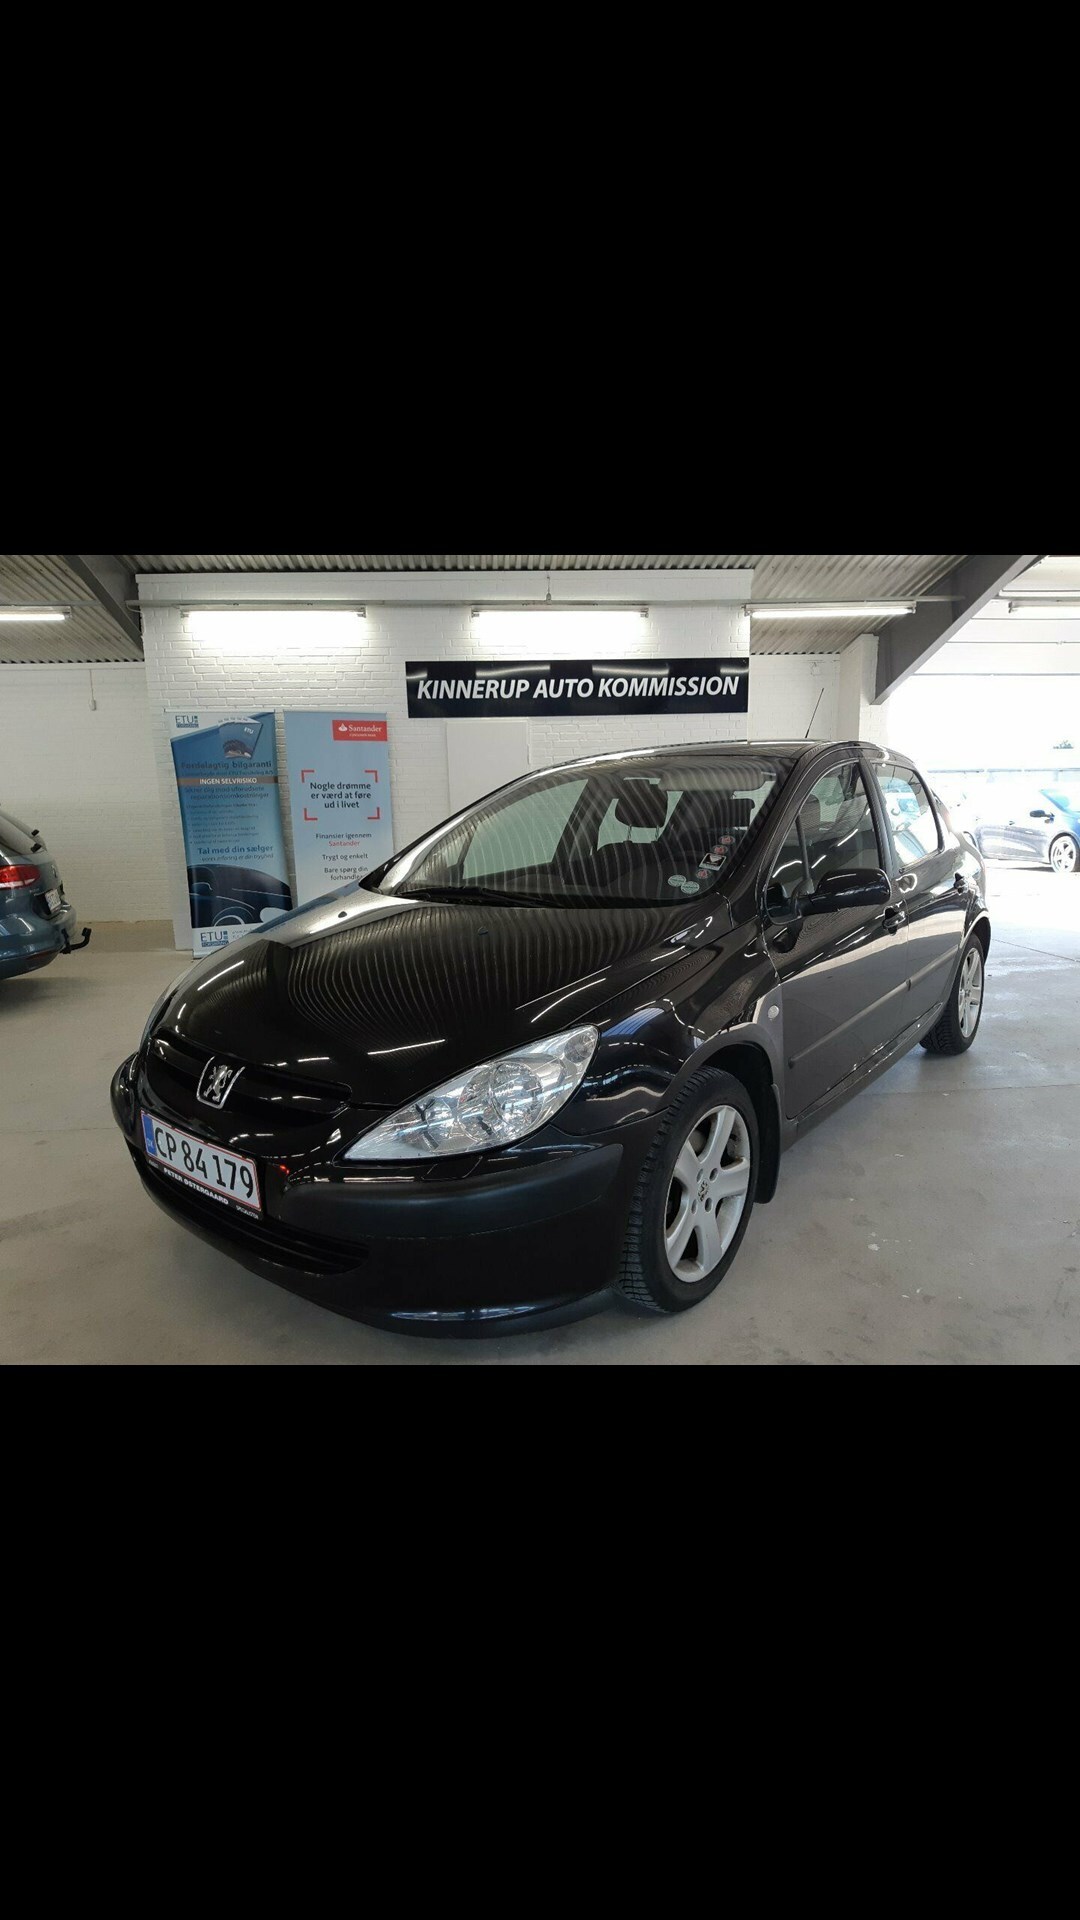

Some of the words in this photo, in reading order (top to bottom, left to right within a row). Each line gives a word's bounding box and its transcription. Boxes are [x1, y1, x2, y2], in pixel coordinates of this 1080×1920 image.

[417, 679, 530, 699] KINNERUP
[532, 677, 594, 699] AUTO
[597, 676, 740, 698] KOMMISSION
[175, 715, 194, 723] ETU
[348, 724, 382, 732] Santander
[181, 761, 229, 769] Fordelagtig
[232, 760, 272, 768] bilgaranti
[221, 777, 258, 785] SELVRISIKO
[309, 782, 335, 791] Nogle
[336, 781, 371, 790] drømme
[321, 791, 343, 799] værd
[354, 791, 371, 799] føre
[341, 800, 360, 808] livet
[345, 832, 372, 840] igennem
[197, 847, 210, 855] Tal
[211, 846, 230, 854] med
[231, 845, 245, 853] din
[246, 845, 274, 854] sælger
[200, 931, 223, 941] ETU
[155, 1127, 177, 1161] CP
[181, 1140, 208, 1179] 84
[212, 1154, 254, 1199] 179
[163, 1167, 184, 1183] PETER
